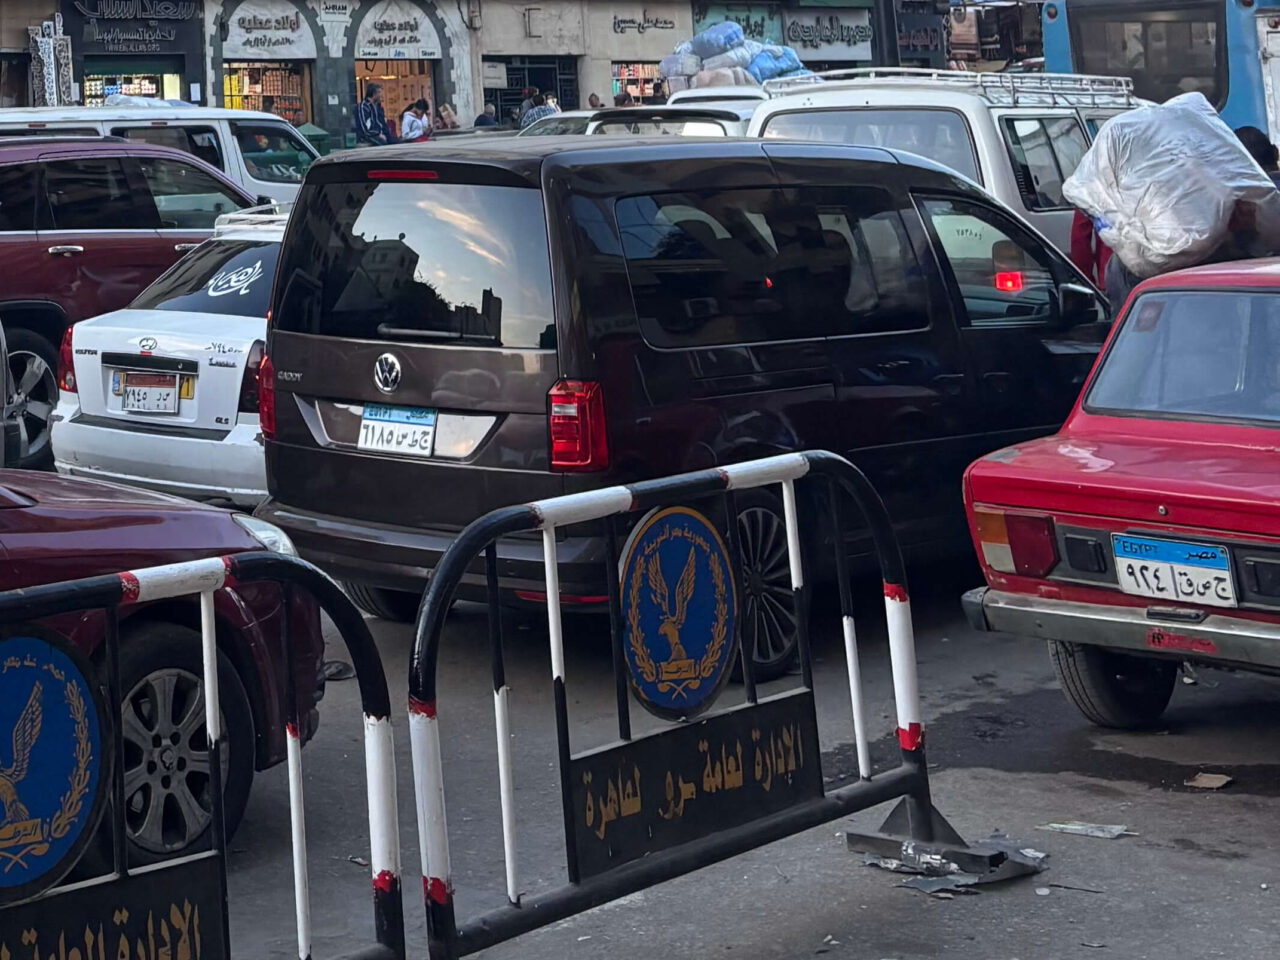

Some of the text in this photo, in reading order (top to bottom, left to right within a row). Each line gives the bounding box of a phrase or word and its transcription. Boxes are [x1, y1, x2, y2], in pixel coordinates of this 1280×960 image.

[363, 424, 394, 447] ٦١٨٥
[1122, 541, 1158, 555] EGYPT
[1184, 548, 1218, 561] مصر
